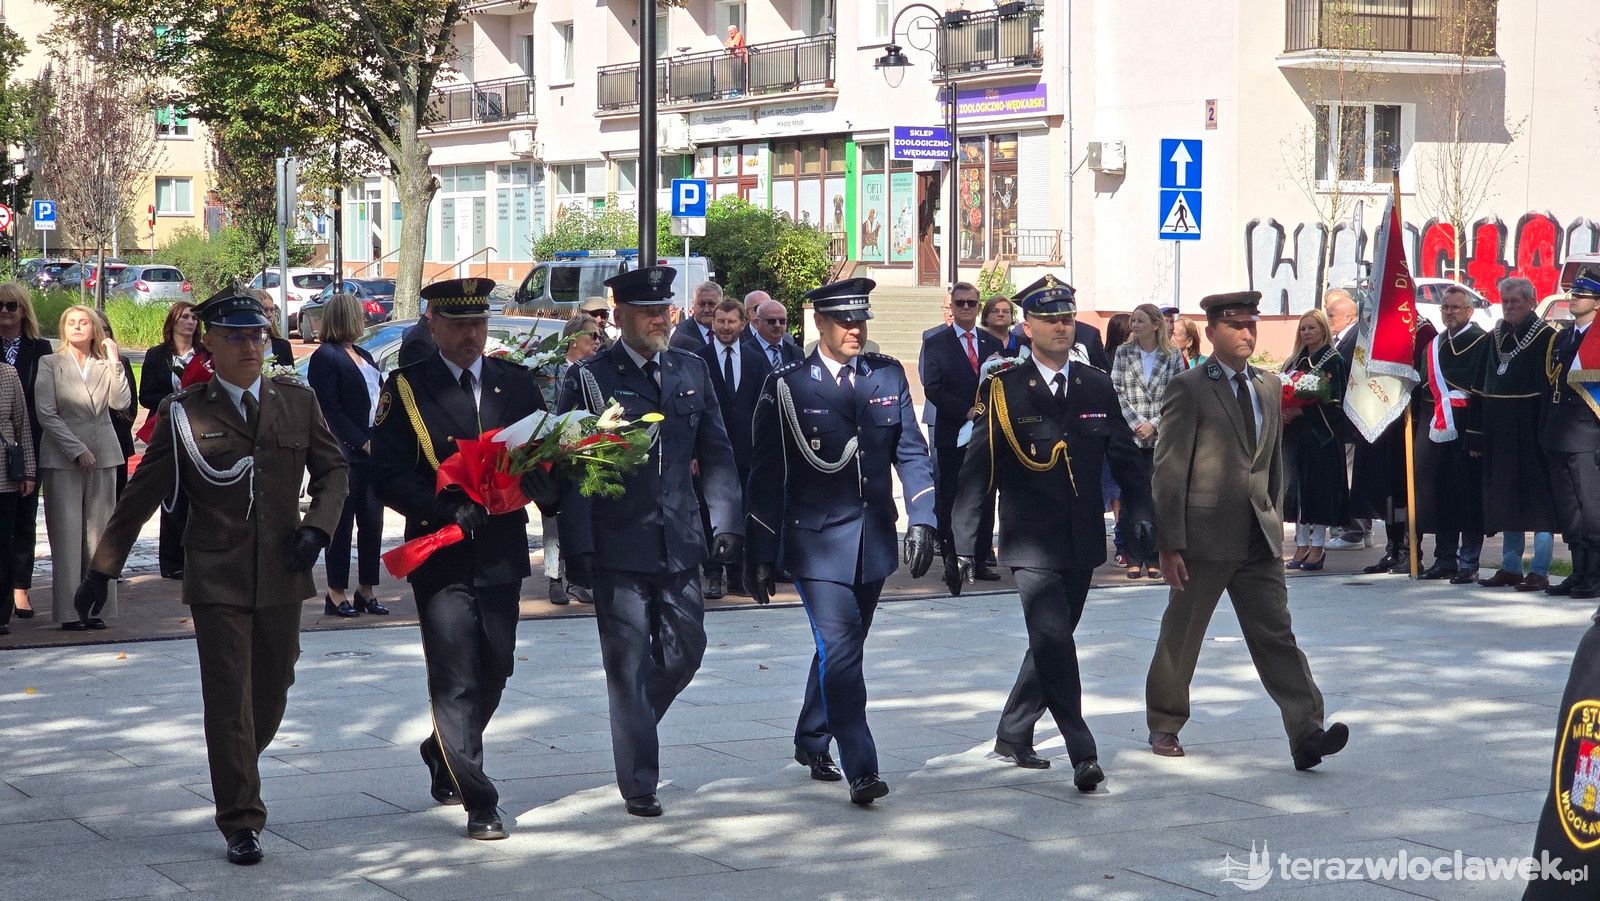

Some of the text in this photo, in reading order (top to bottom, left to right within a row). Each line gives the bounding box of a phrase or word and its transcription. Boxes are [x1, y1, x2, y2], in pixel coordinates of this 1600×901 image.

[959, 97, 1045, 114] ZOOLOGICZNO-WĘDKARSKI
[1208, 107, 1214, 121] 2
[909, 129, 934, 137] SKLEP
[895, 139, 952, 148] ZOOLOGICZNO-
[903, 149, 948, 158] WĘDKARSKI
[866, 183, 882, 194] OPTI
[680, 184, 699, 212] P
[39, 203, 51, 219] P
[1367, 379, 1389, 403] 2019
[1582, 707, 1600, 724] ST
